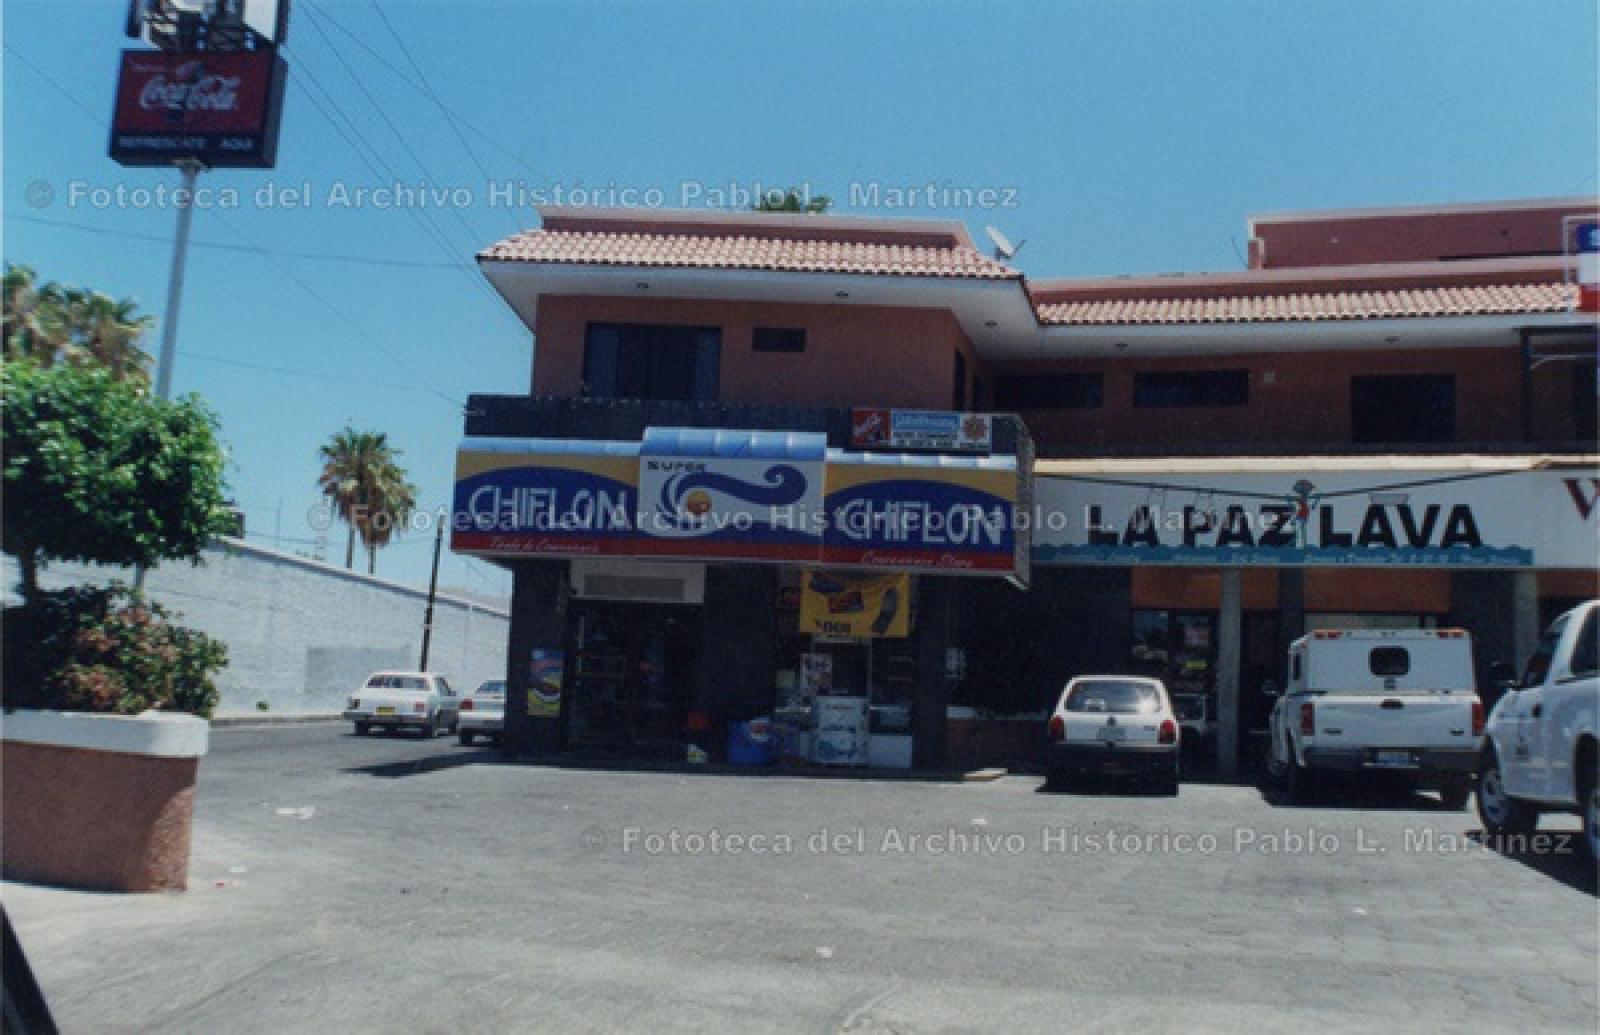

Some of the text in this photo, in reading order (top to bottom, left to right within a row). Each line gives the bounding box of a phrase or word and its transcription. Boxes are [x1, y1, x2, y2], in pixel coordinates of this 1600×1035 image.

[469, 485, 633, 531] CHIFLON
[836, 499, 1006, 546] CHIFLON
[1088, 504, 1481, 548] LA PAZ LAVA
